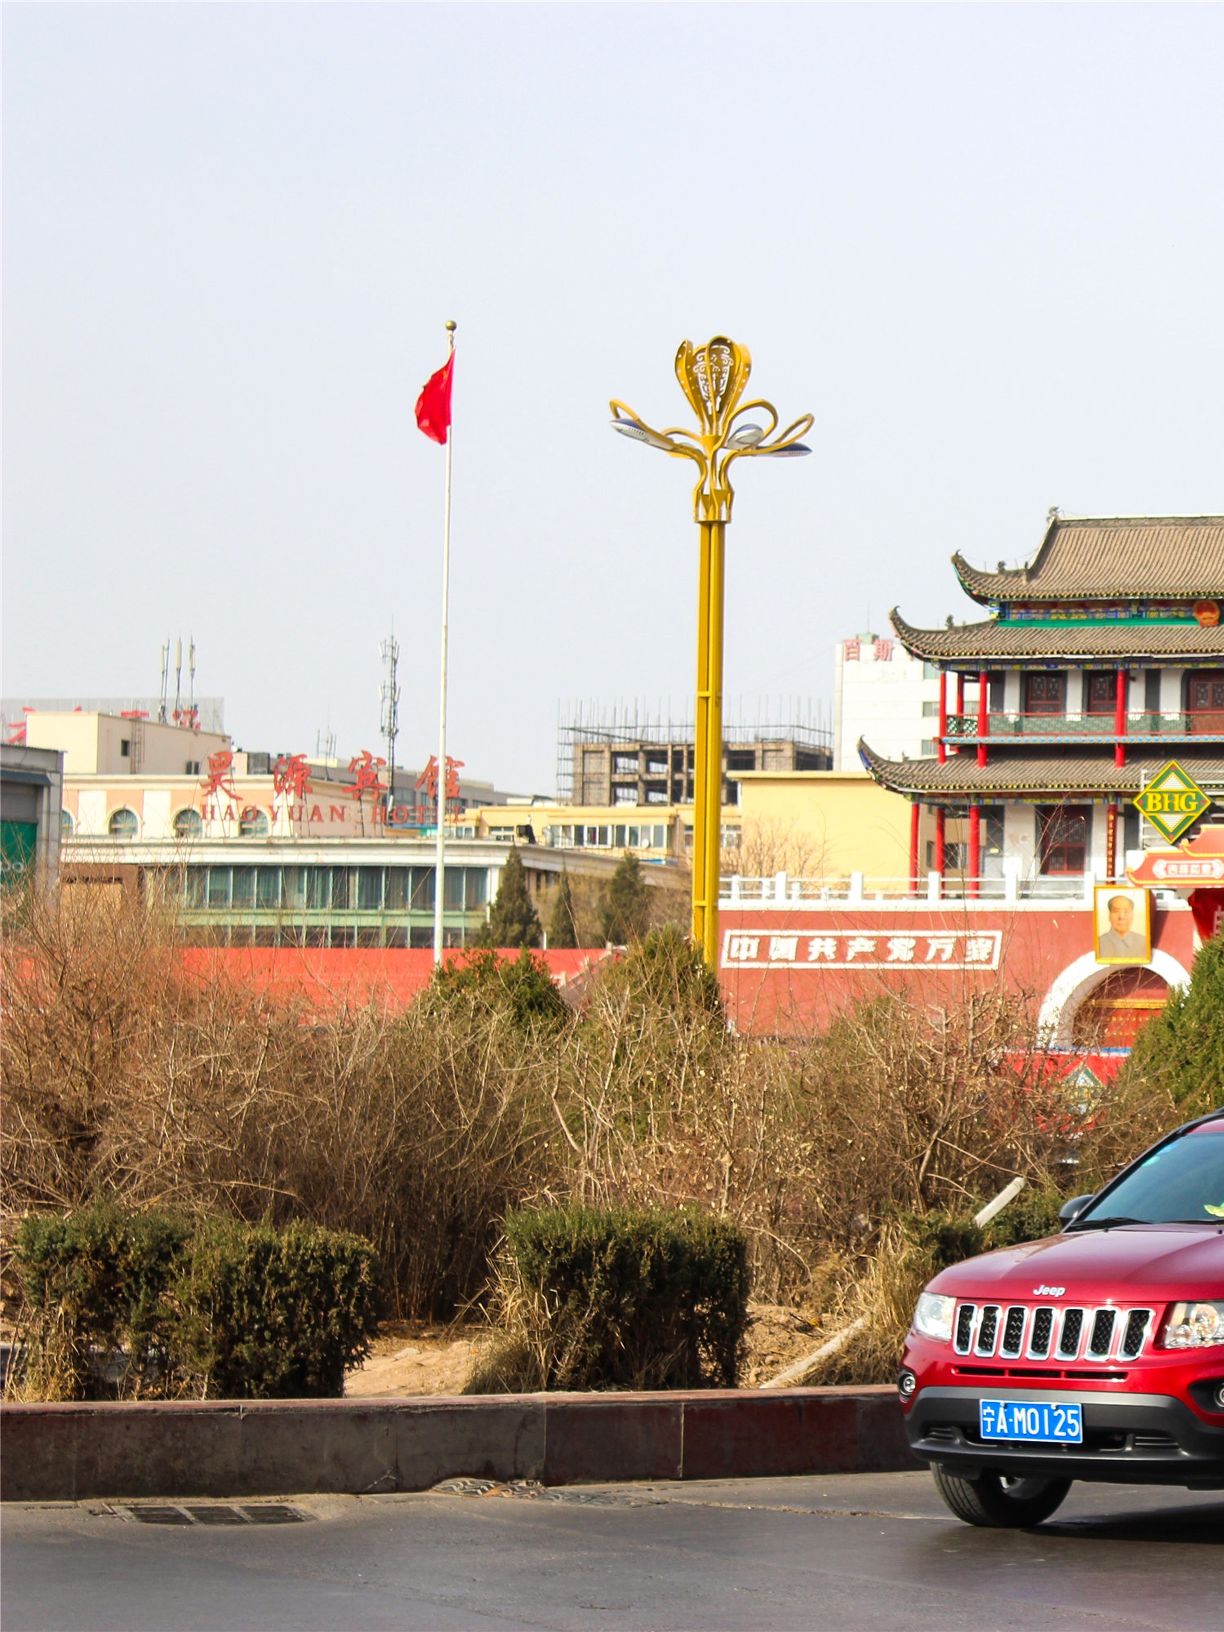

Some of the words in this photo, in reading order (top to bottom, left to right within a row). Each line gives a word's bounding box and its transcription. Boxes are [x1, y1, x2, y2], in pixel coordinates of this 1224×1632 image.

[1146, 793, 1198, 812] BHG
[200, 804, 346, 823] HAOYUAN
[371, 804, 466, 824] HOTL
[1033, 1285, 1066, 1298] Jeep
